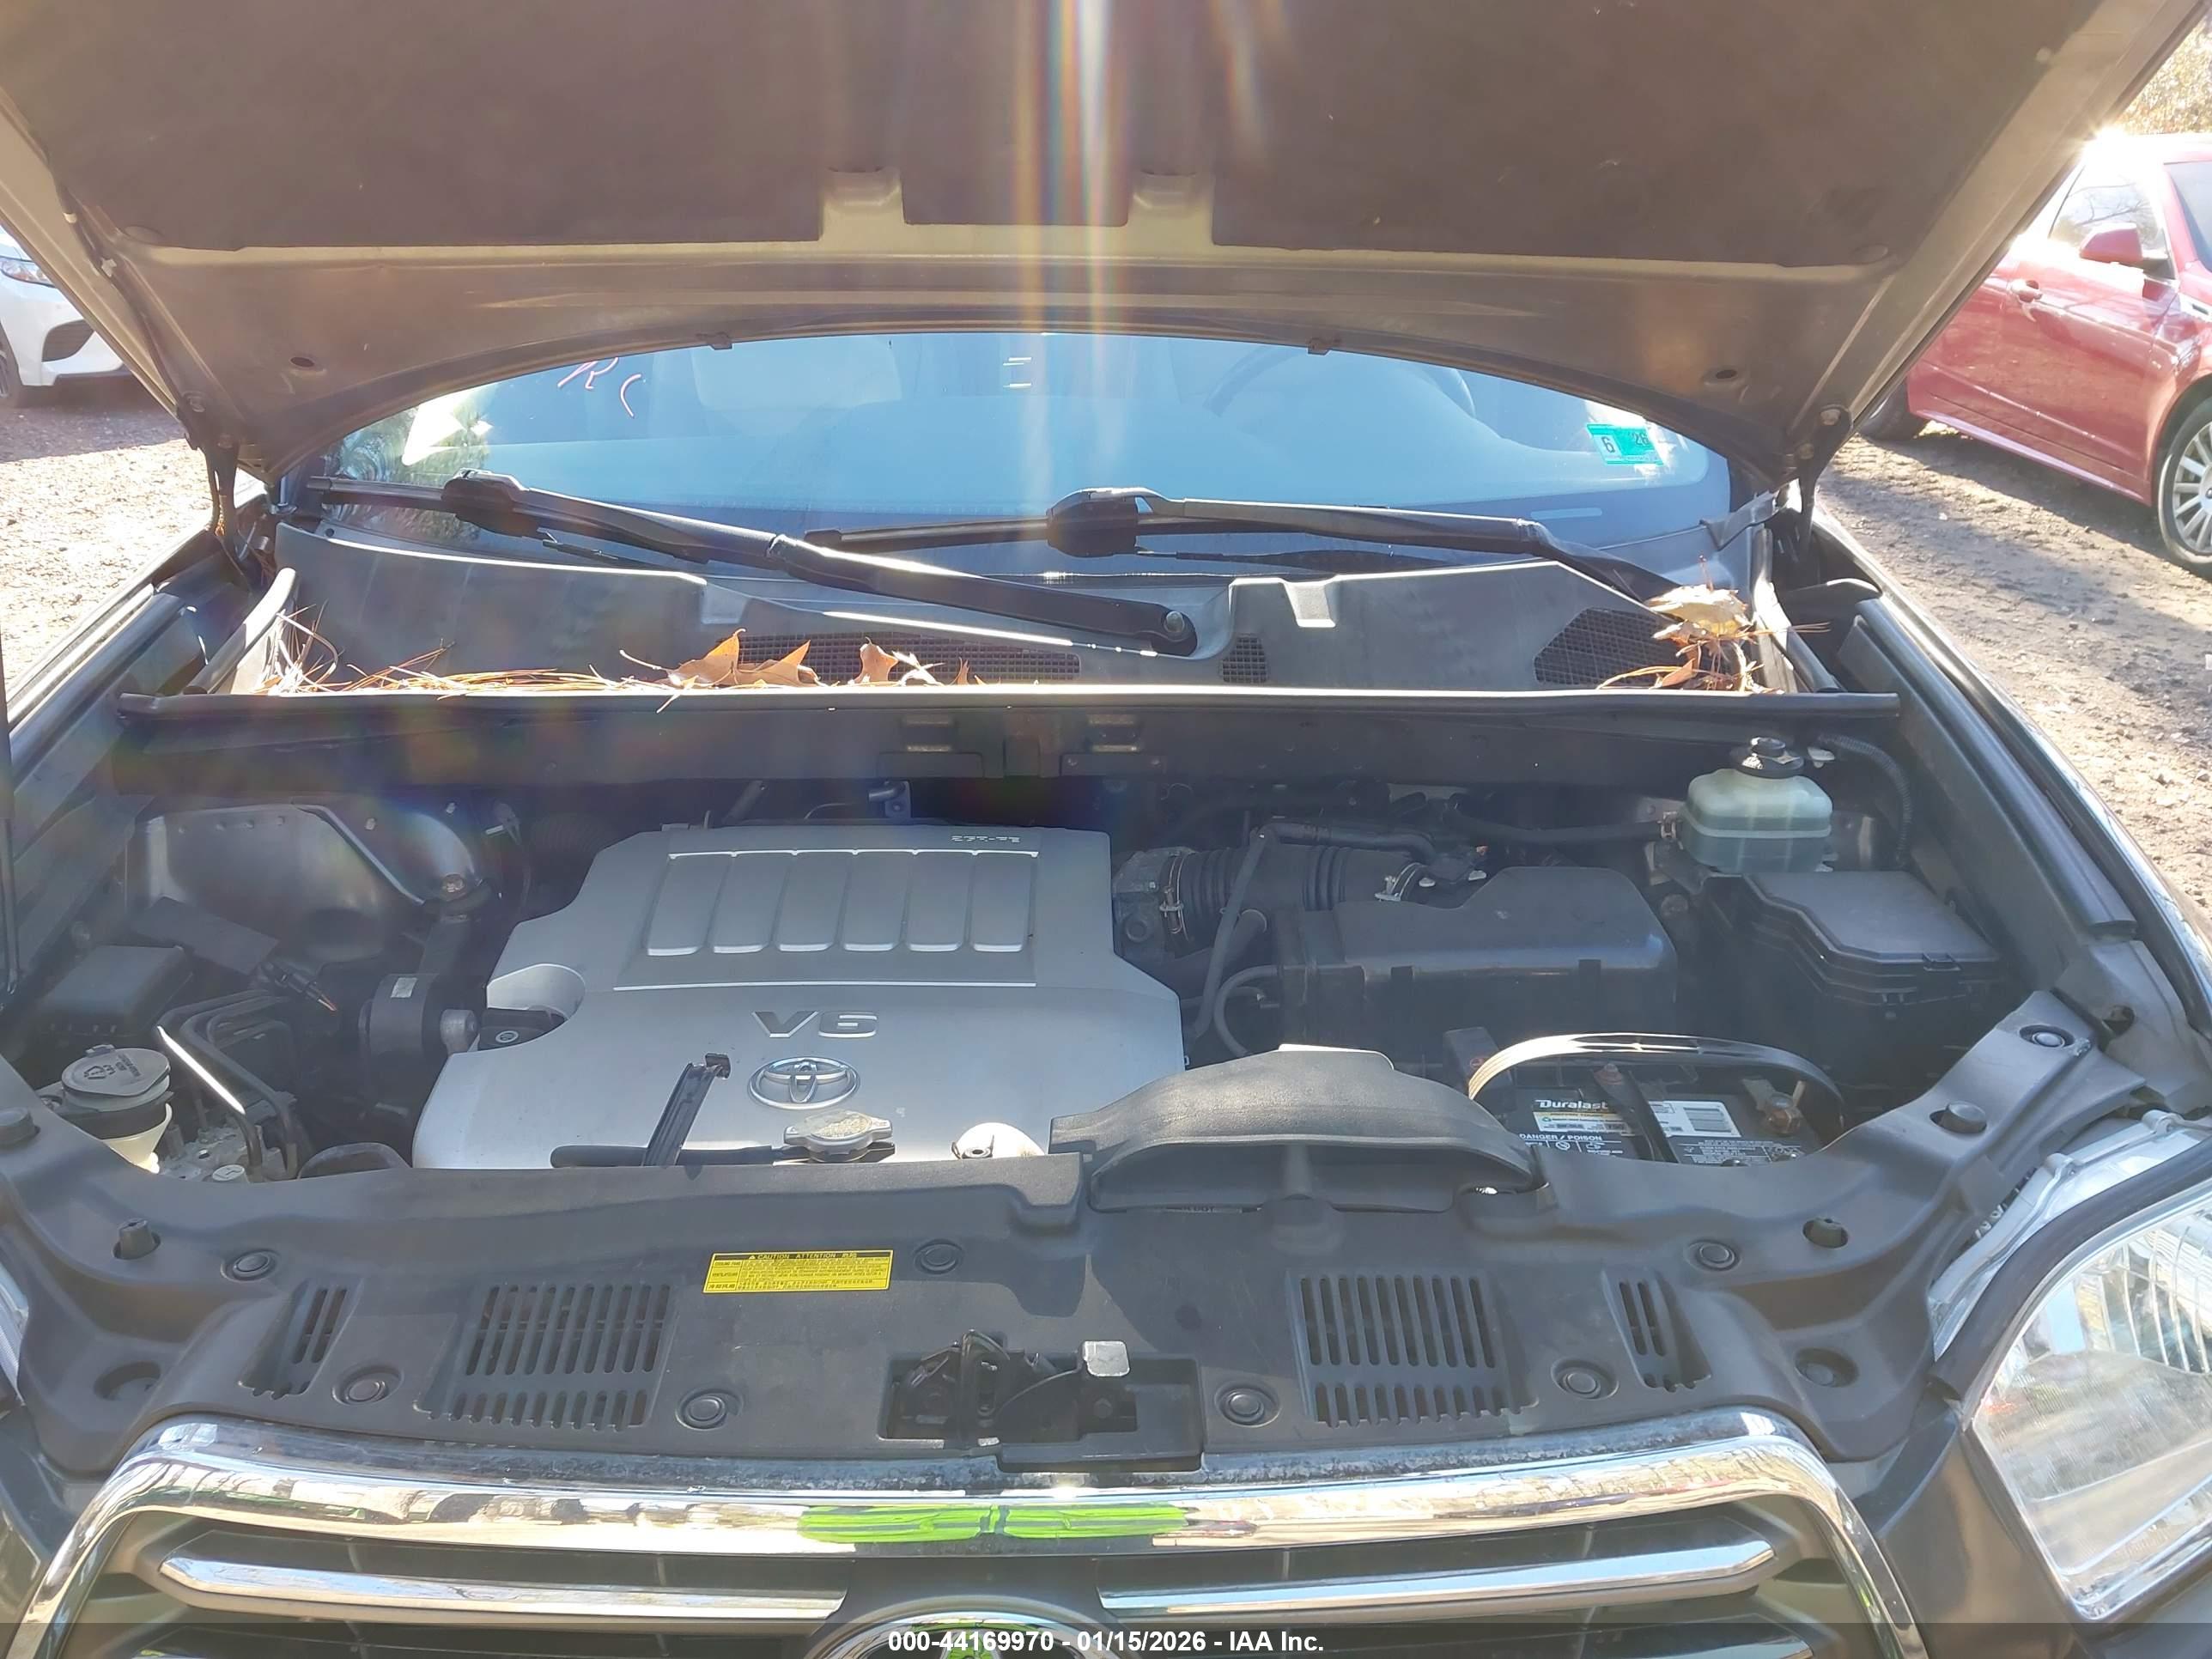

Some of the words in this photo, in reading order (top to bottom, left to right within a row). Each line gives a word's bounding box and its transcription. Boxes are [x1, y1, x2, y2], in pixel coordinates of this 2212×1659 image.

[1601, 436, 1616, 453] 6
[750, 1011, 878, 1038] V6
[1534, 1099, 1609, 1109] Duralast
